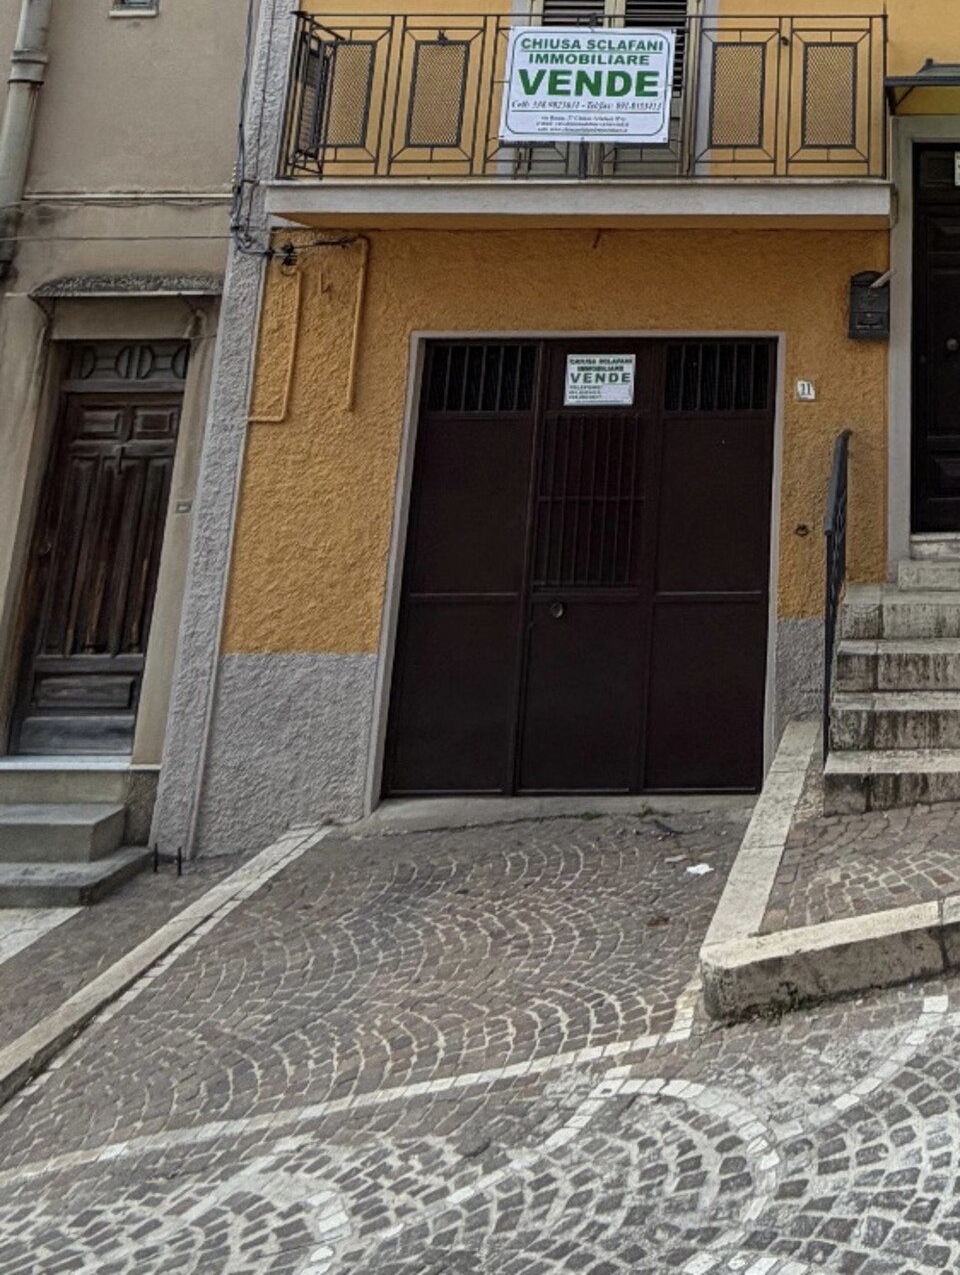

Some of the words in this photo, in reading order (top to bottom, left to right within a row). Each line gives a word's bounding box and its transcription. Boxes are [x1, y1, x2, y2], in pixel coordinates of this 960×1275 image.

[520, 38, 581, 50] CHIUSA
[586, 39, 663, 51] SCLAFANI
[529, 53, 650, 66] IMMOBILIARE
[518, 69, 660, 97] VENDE
[570, 372, 632, 383] VENDE
